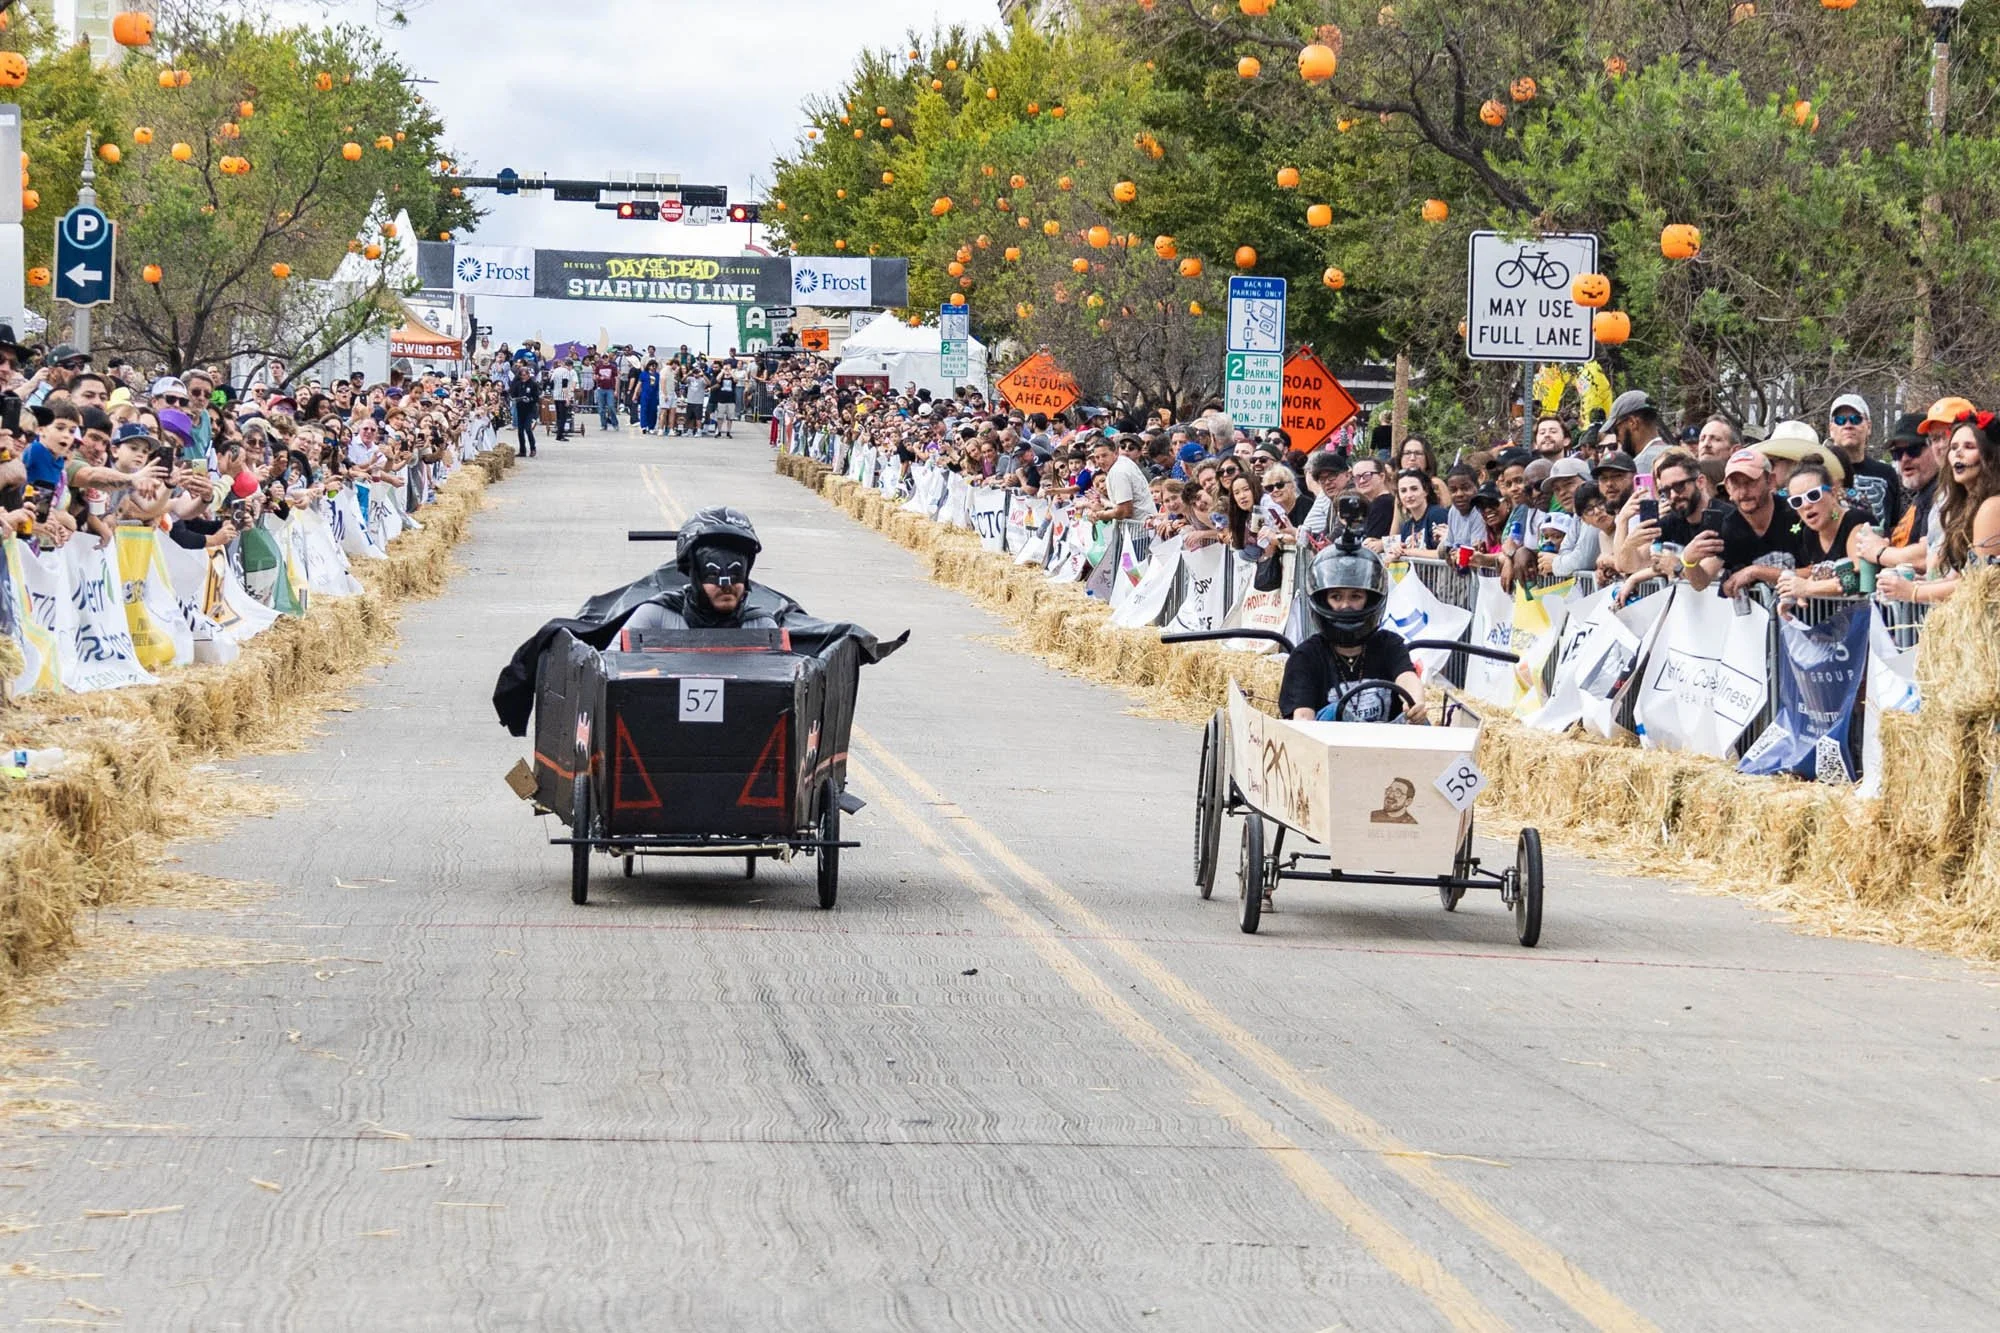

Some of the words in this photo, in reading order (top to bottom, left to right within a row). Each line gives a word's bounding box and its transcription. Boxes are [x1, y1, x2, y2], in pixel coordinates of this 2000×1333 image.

[76, 214, 99, 241] P
[606, 258, 648, 279] DAY
[648, 257, 667, 269] OF
[667, 258, 720, 280] DEAD
[719, 267, 761, 275] FESTIVAL
[486, 262, 531, 281] Frost
[645, 267, 670, 279] THE
[568, 278, 692, 300] STARTING
[821, 273, 867, 291] Frost
[696, 282, 756, 302] LINE
[1232, 288, 1261, 297] PARKING
[1264, 290, 1282, 298] ONLY
[1489, 298, 1528, 317] MAY
[1538, 299, 1574, 319] USE
[1479, 325, 1524, 345] FULL
[1536, 326, 1583, 347] LANE
[436, 345, 456, 357] CO.
[943, 343, 950, 354] 2
[1230, 358, 1244, 377] 2
[1245, 368, 1279, 380] PARKING
[1235, 384, 1256, 394] 8:00
[1258, 385, 1272, 395] AM
[1283, 375, 1322, 391] ROAD
[1015, 391, 1062, 408] AHEAD
[1230, 399, 1240, 409] TO
[1242, 399, 1262, 410] 5:00
[1265, 400, 1277, 410] PM
[1282, 394, 1322, 410] WORK
[1259, 414, 1273, 424] FRI
[1811, 669, 1855, 683] GROUP
[685, 688, 718, 712] 57
[1446, 765, 1478, 802] 58
